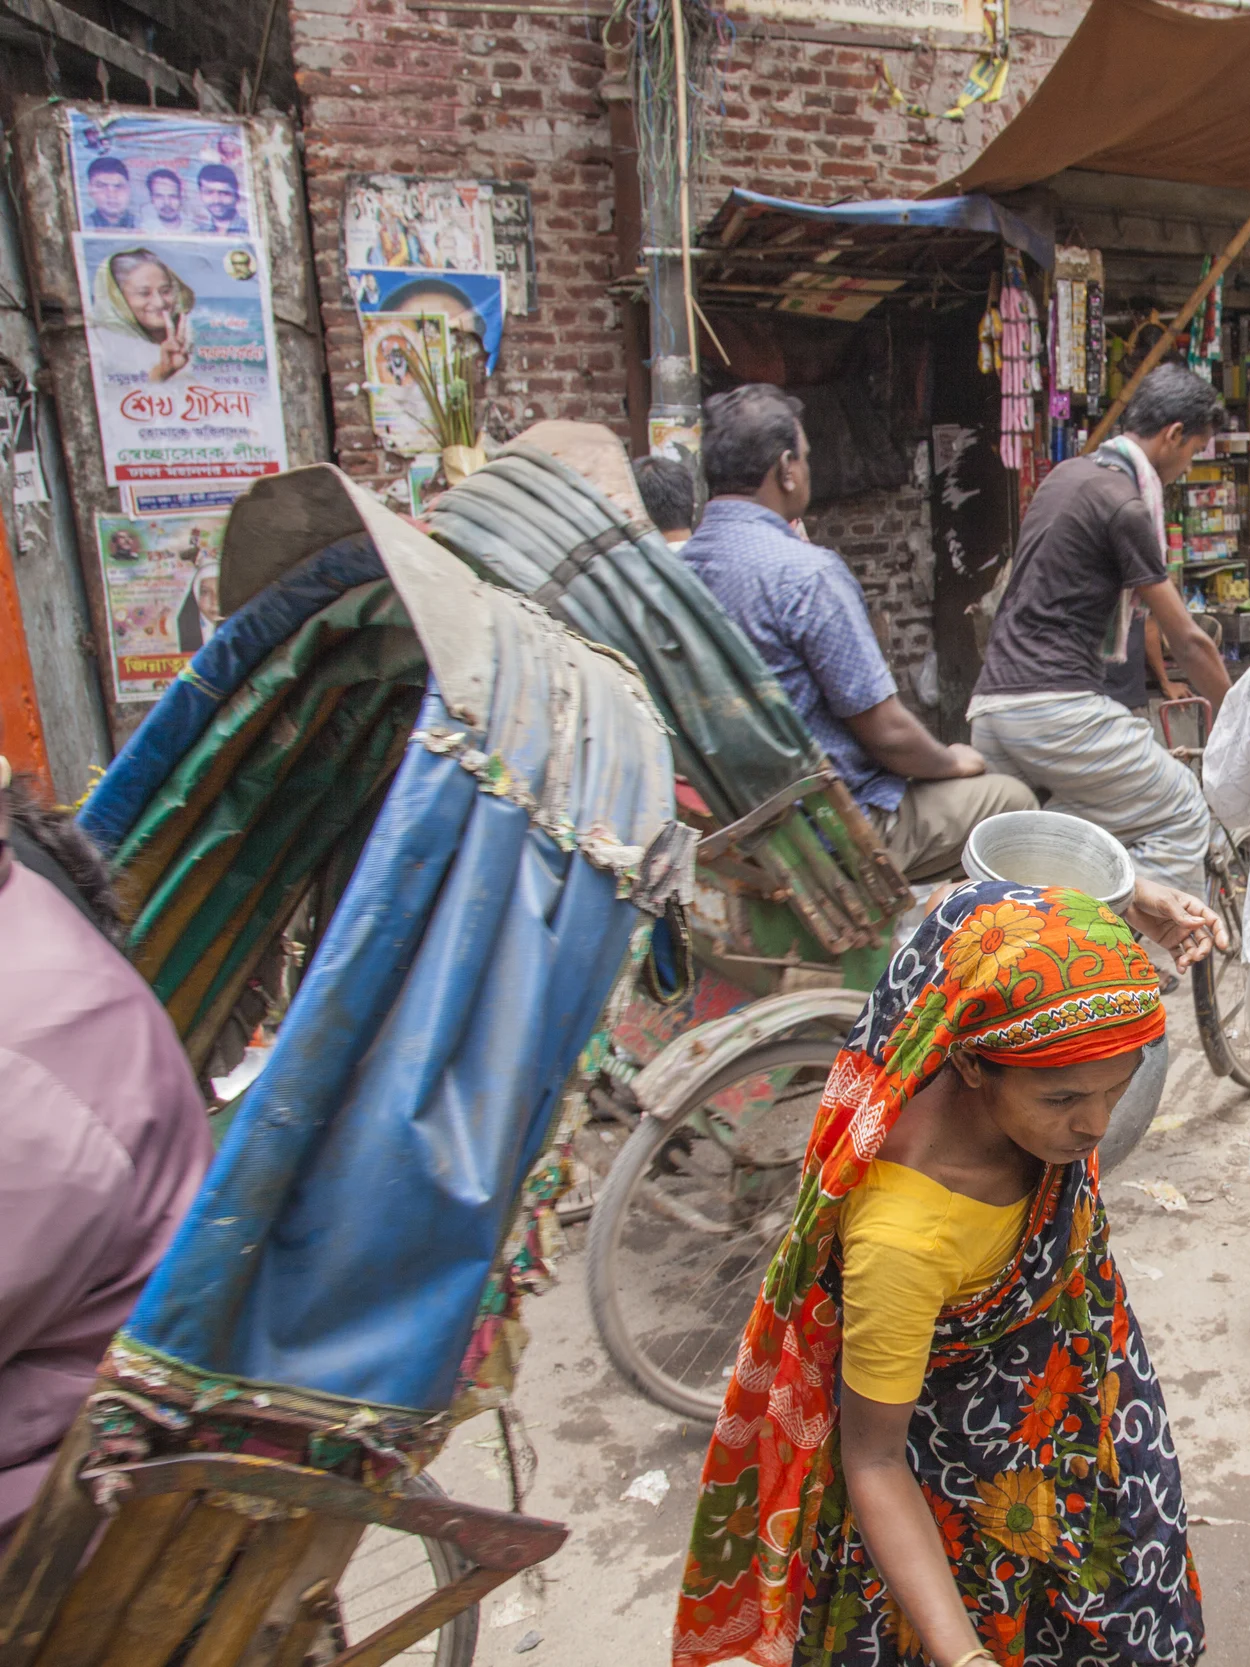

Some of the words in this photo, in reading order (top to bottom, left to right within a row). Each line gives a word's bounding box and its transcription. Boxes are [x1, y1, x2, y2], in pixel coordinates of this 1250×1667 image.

[120, 388, 173, 422] শেখ
[181, 385, 259, 422] হাসিনা
[232, 441, 269, 461] লীগ
